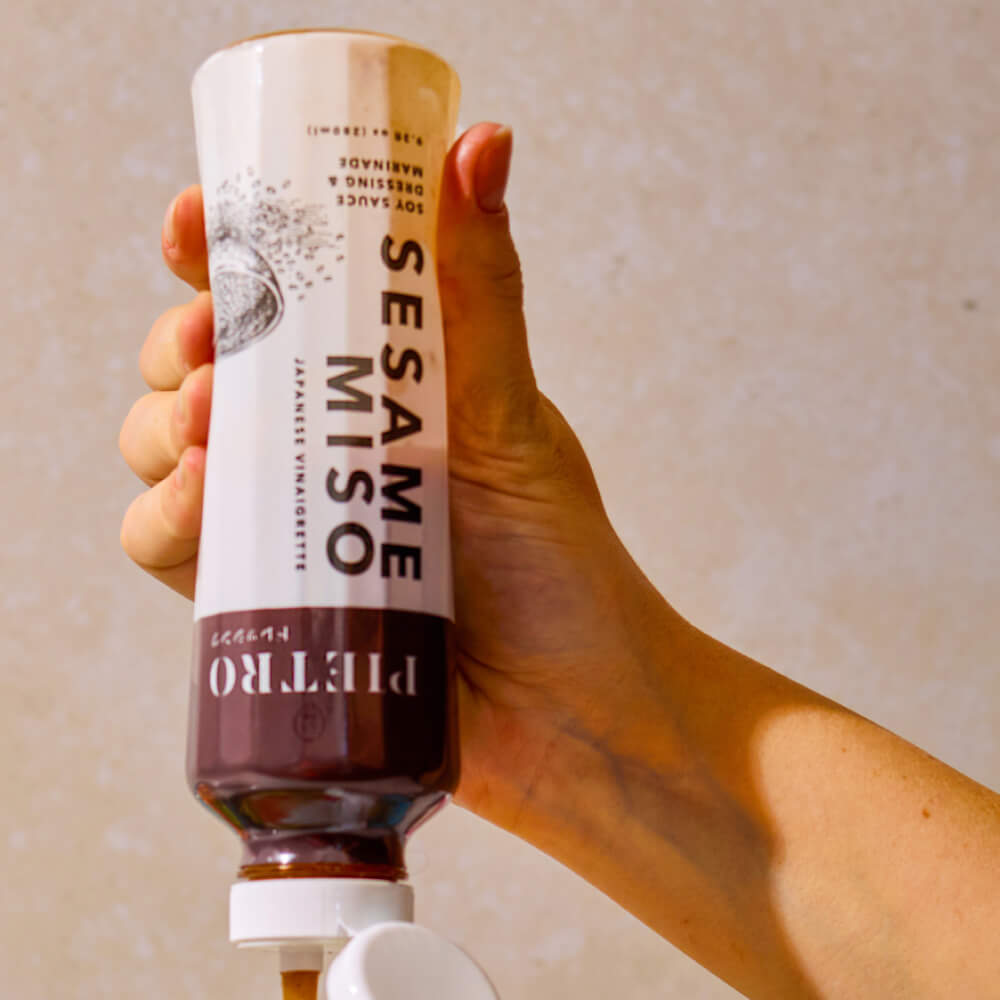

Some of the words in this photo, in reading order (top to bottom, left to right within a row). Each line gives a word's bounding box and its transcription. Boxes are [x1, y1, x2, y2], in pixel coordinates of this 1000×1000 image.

[328, 176, 338, 187] &
[339, 157, 423, 178] MARINADE
[336, 194, 390, 208] SAUCE
[345, 176, 424, 197] DRESSING
[396, 200, 424, 215] SOY
[294, 358, 306, 445] JAPANESE
[381, 234, 424, 581] SESAME
[326, 355, 375, 576] MISO
[294, 454, 307, 572] VINAIGRETTE
[209, 651, 417, 697] PIETRO
